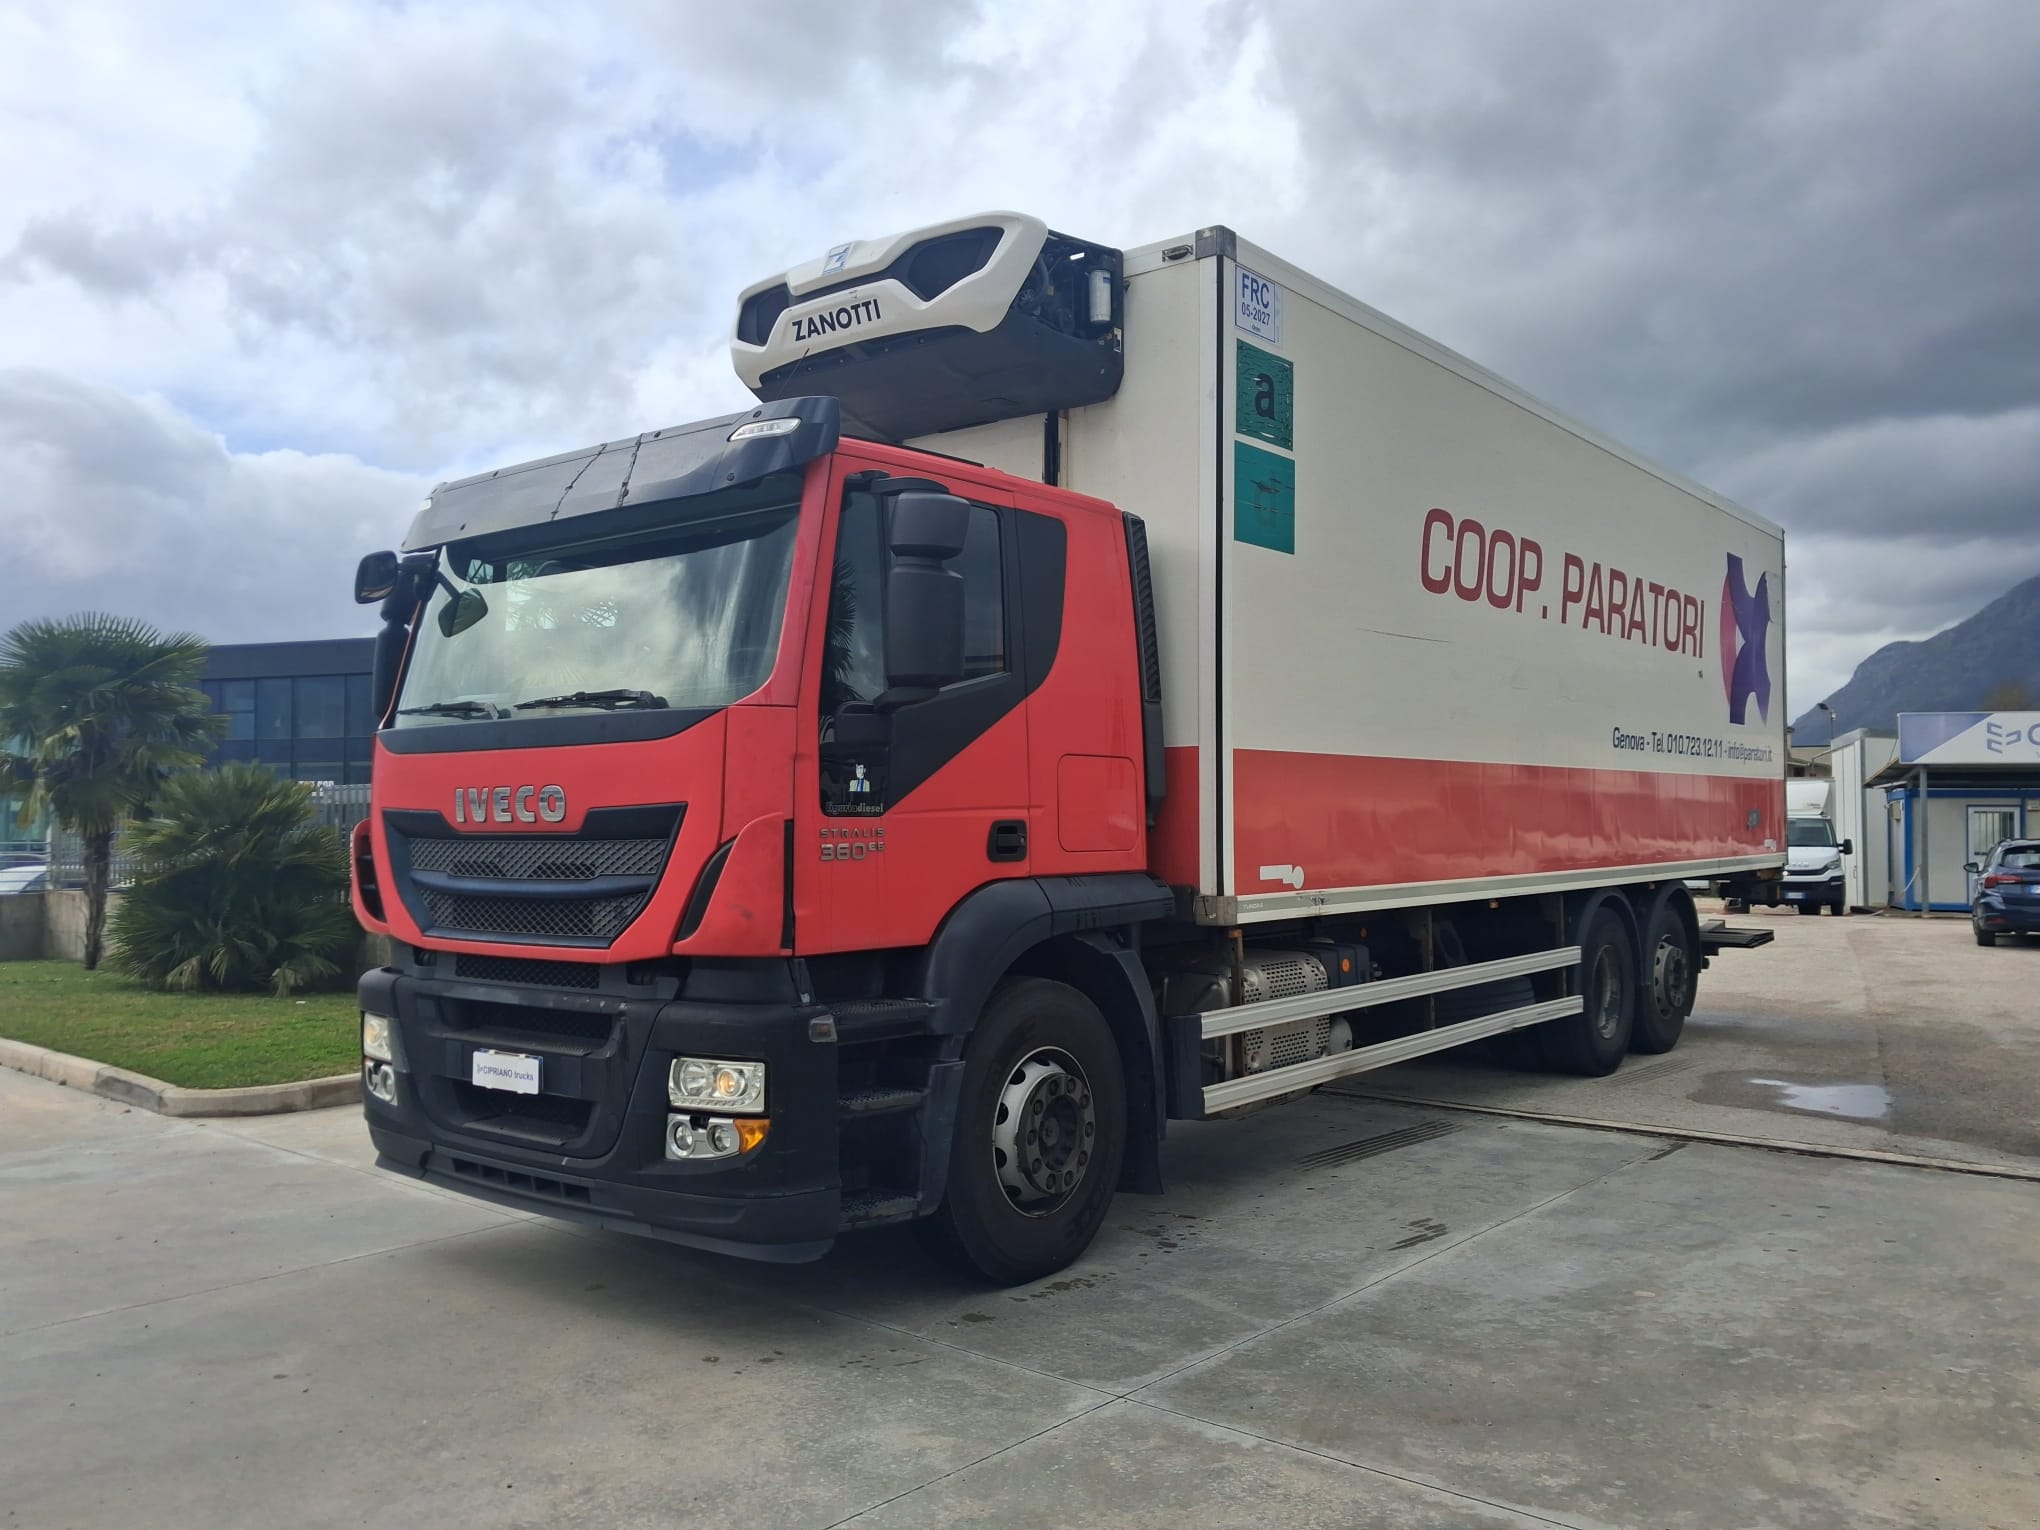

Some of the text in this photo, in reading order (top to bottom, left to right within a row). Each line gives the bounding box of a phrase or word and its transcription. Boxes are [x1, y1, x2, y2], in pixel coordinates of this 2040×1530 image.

[1242, 272, 1270, 309] FRC
[791, 298, 881, 342] ZANOTTI
[1241, 302, 1271, 327] 05-2027
[1420, 508, 1705, 659] COOP. PARATORI
[1612, 726, 1645, 751] Genova
[1667, 733, 1723, 758] 010.723.12.11
[455, 784, 567, 822] IVECO
[820, 827, 885, 838] STRALIS
[820, 842, 866, 861] 360
[483, 1064, 534, 1081] CIPRIANO trucks
